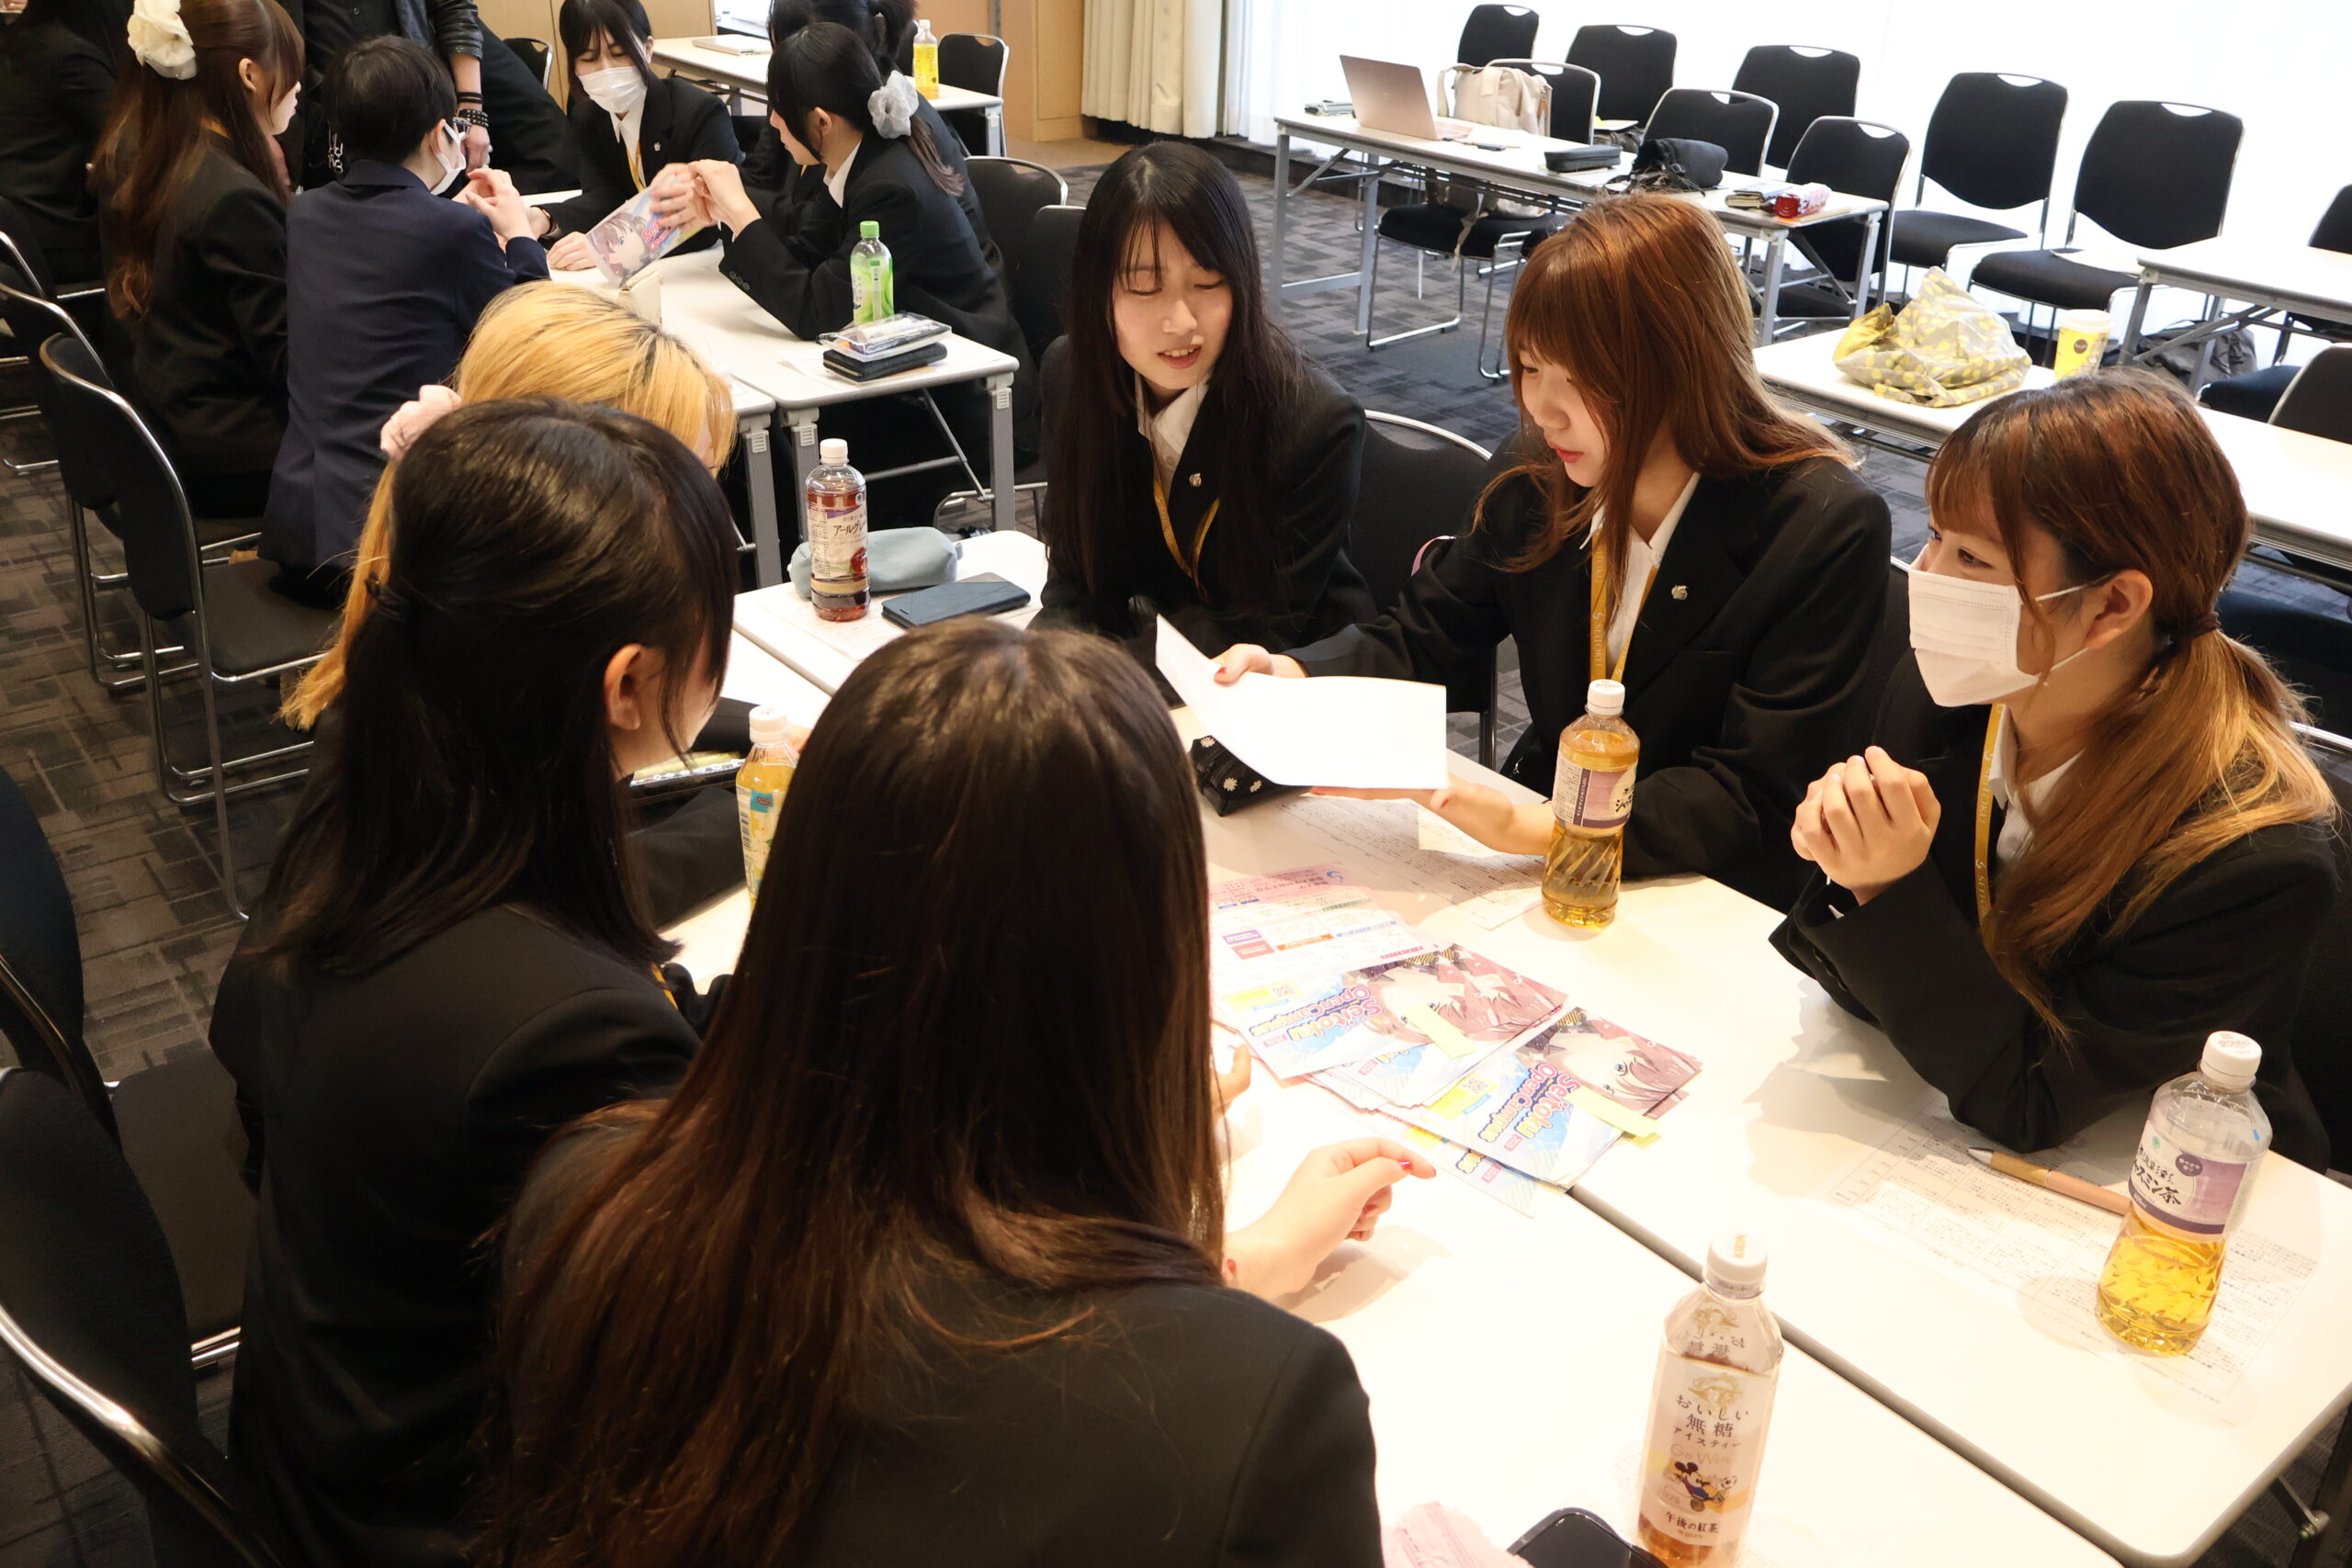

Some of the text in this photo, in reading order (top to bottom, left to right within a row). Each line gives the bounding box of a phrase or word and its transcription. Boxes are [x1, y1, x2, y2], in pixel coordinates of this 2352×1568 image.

[1594, 624, 1604, 667] SEITOKU
[1249, 986, 1371, 1037] OpenCampus
[1289, 998, 1385, 1042] Seitoku
[1478, 1063, 1560, 1143] OpenCampus
[1516, 1073, 1582, 1139] Seitoku
[2133, 1158, 2182, 1205] ャスミン茶
[1676, 1394, 1749, 1421] おいしい
[1686, 1413, 1734, 1438] 無糖
[1672, 1426, 1741, 1450] アイスティー
[1665, 1511, 1720, 1534] 午後の紅茶
